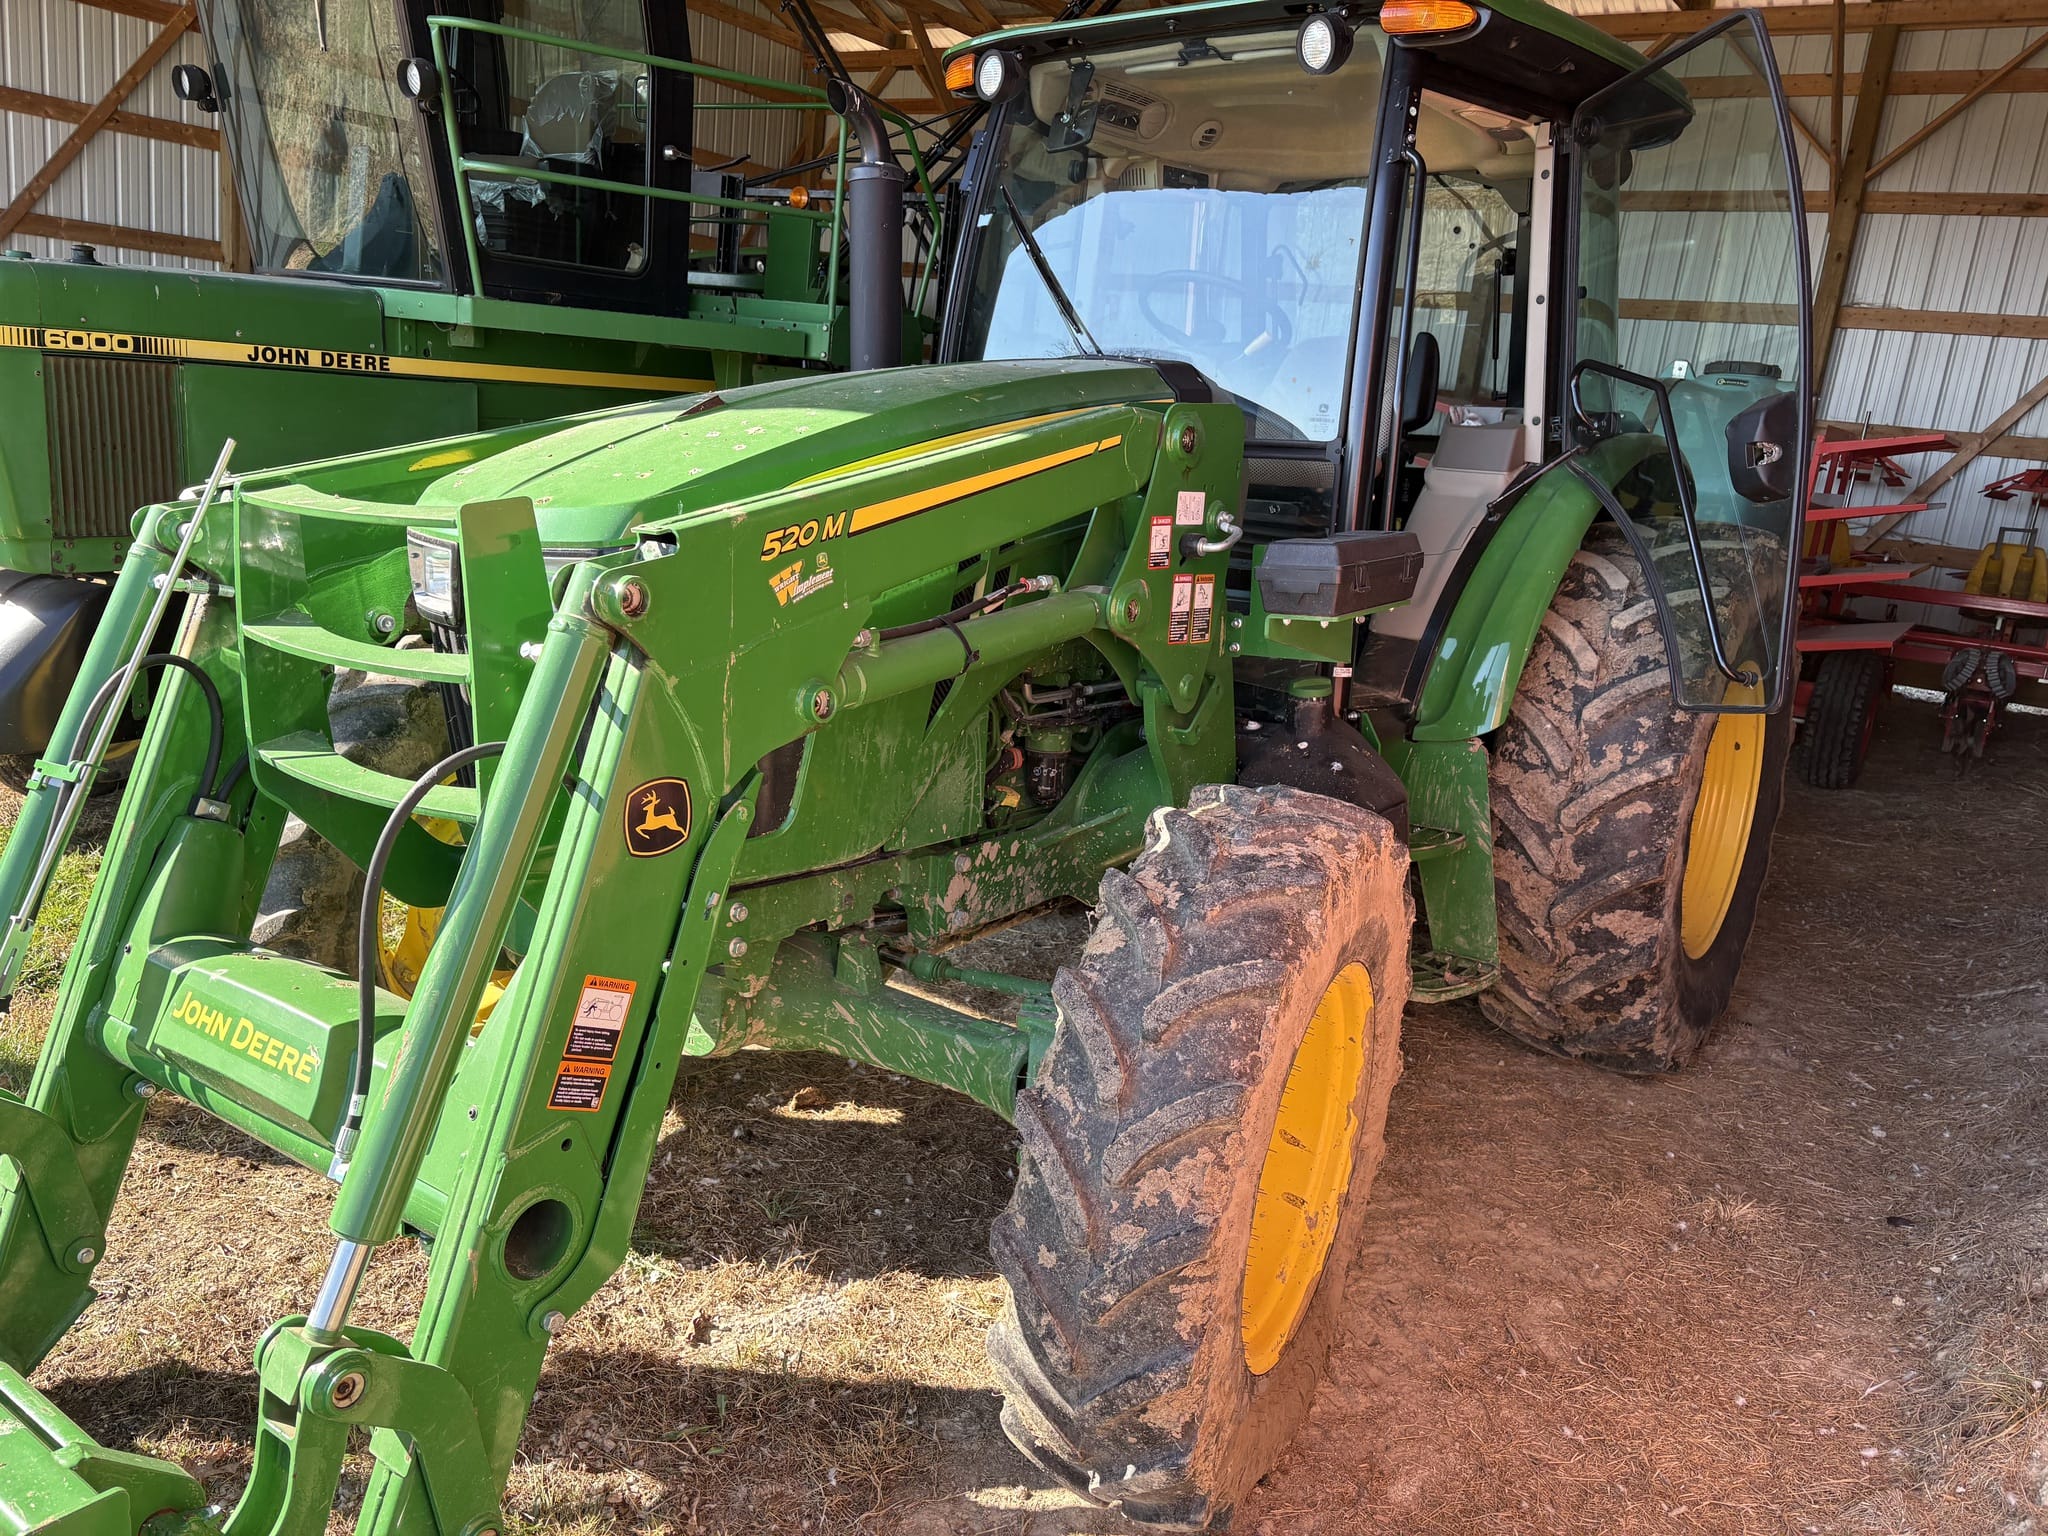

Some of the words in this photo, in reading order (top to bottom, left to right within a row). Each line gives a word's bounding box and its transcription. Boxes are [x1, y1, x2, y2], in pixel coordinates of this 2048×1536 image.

[45, 331, 134, 352] 6000
[247, 345, 310, 366] JOHN
[320, 353, 391, 372] DEERE
[760, 519, 820, 561] 520
[821, 510, 847, 542] M
[598, 980, 630, 991] WARNING
[172, 991, 233, 1041] JOHN
[230, 1017, 317, 1084] DEERE
[573, 1065, 606, 1075] WARNING
